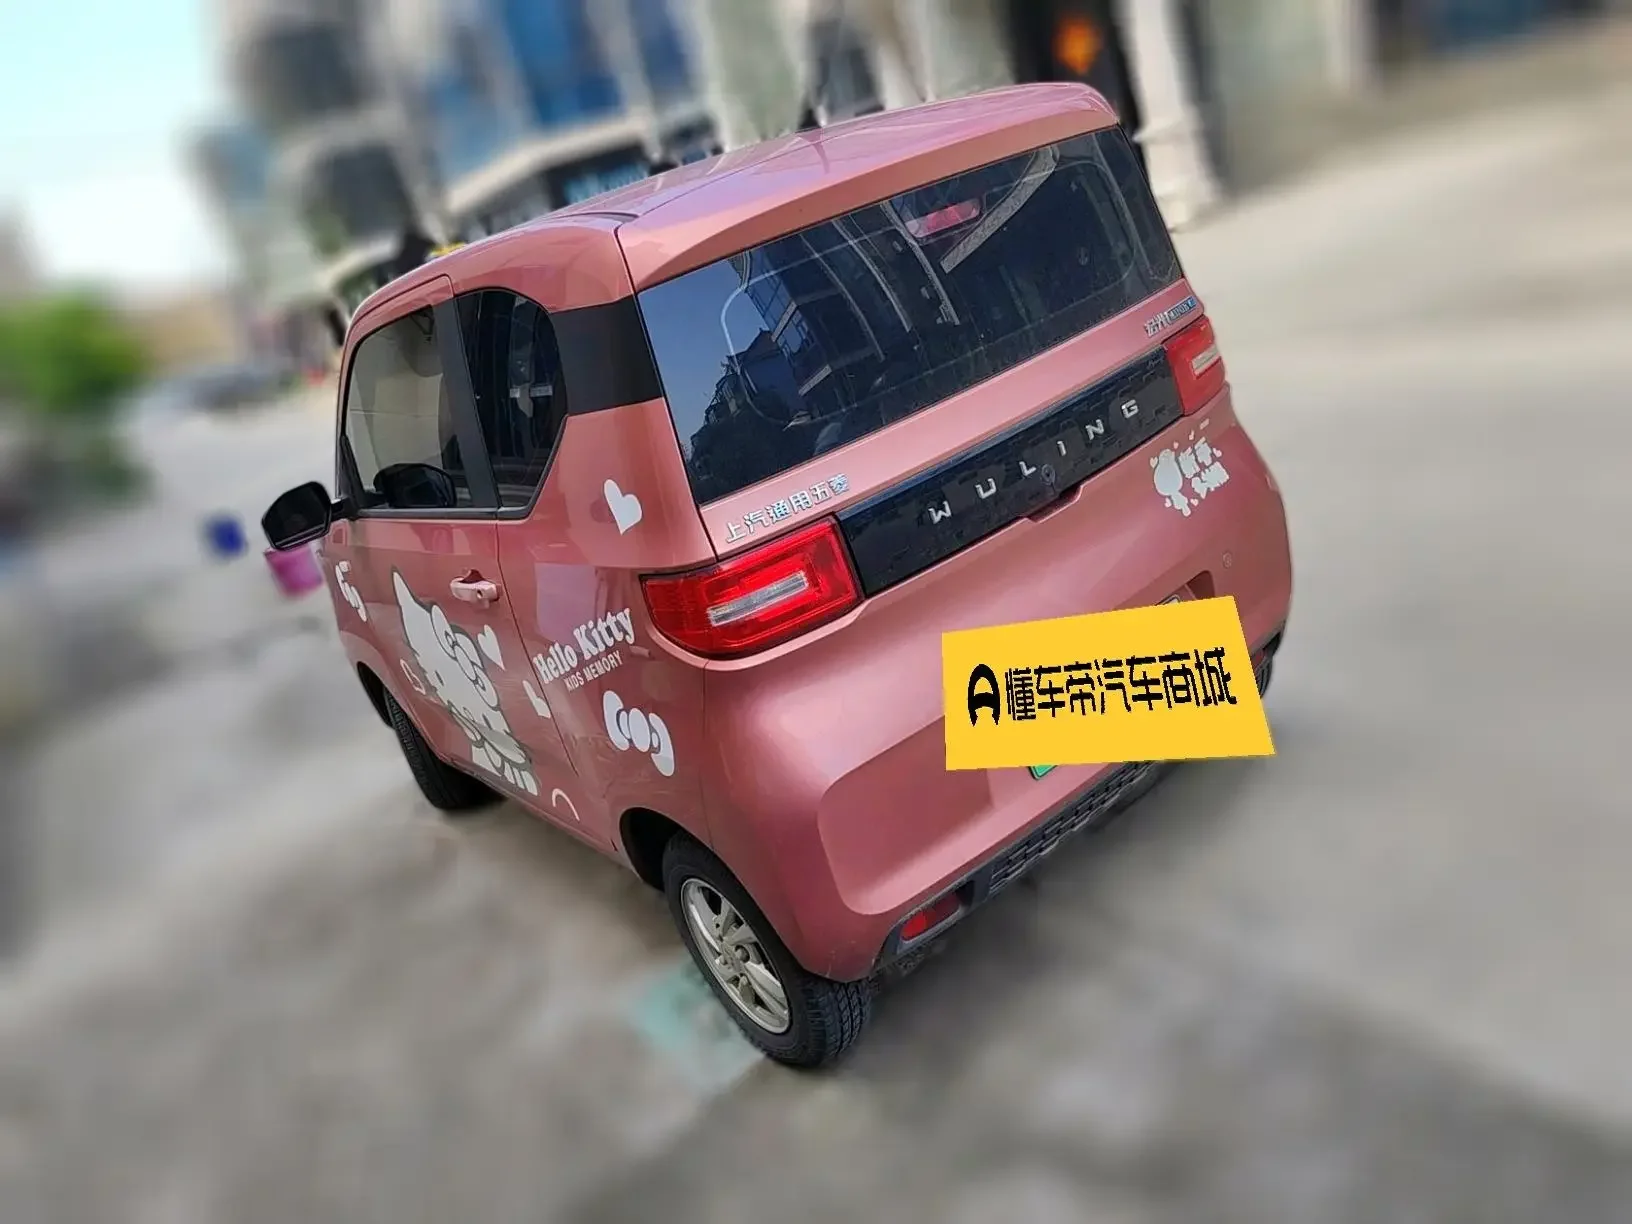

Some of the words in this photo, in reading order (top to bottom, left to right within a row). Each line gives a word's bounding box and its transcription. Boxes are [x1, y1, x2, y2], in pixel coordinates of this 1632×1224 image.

[928, 399, 1139, 524] WULING
[725, 473, 849, 543] 上汽通用五菱
[533, 642, 578, 684] Hello
[573, 607, 635, 660] Kitty
[563, 671, 584, 693] KIDS
[582, 650, 623, 682] MEMORY
